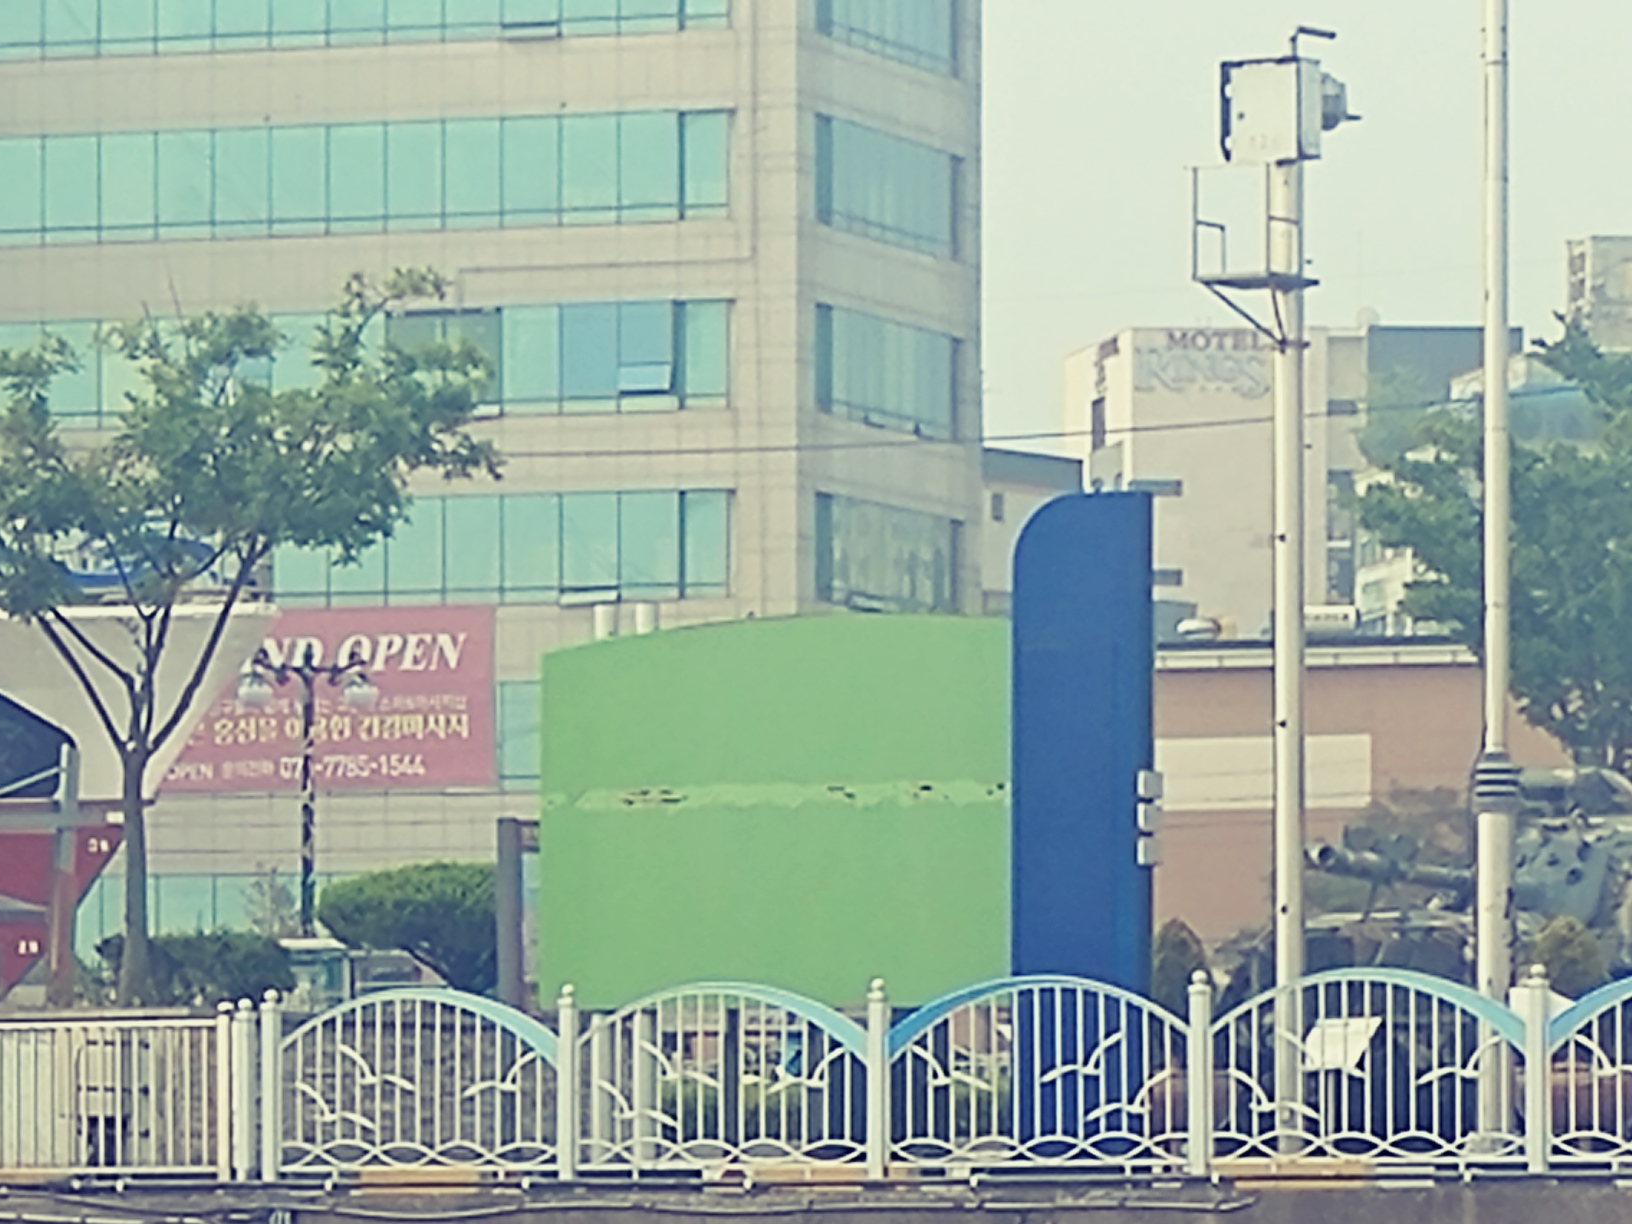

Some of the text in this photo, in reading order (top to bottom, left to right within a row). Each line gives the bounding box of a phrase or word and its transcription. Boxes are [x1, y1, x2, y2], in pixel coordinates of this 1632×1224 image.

[1168, 331, 1260, 351] MOTEL
[241, 632, 467, 675] ND OPEN
